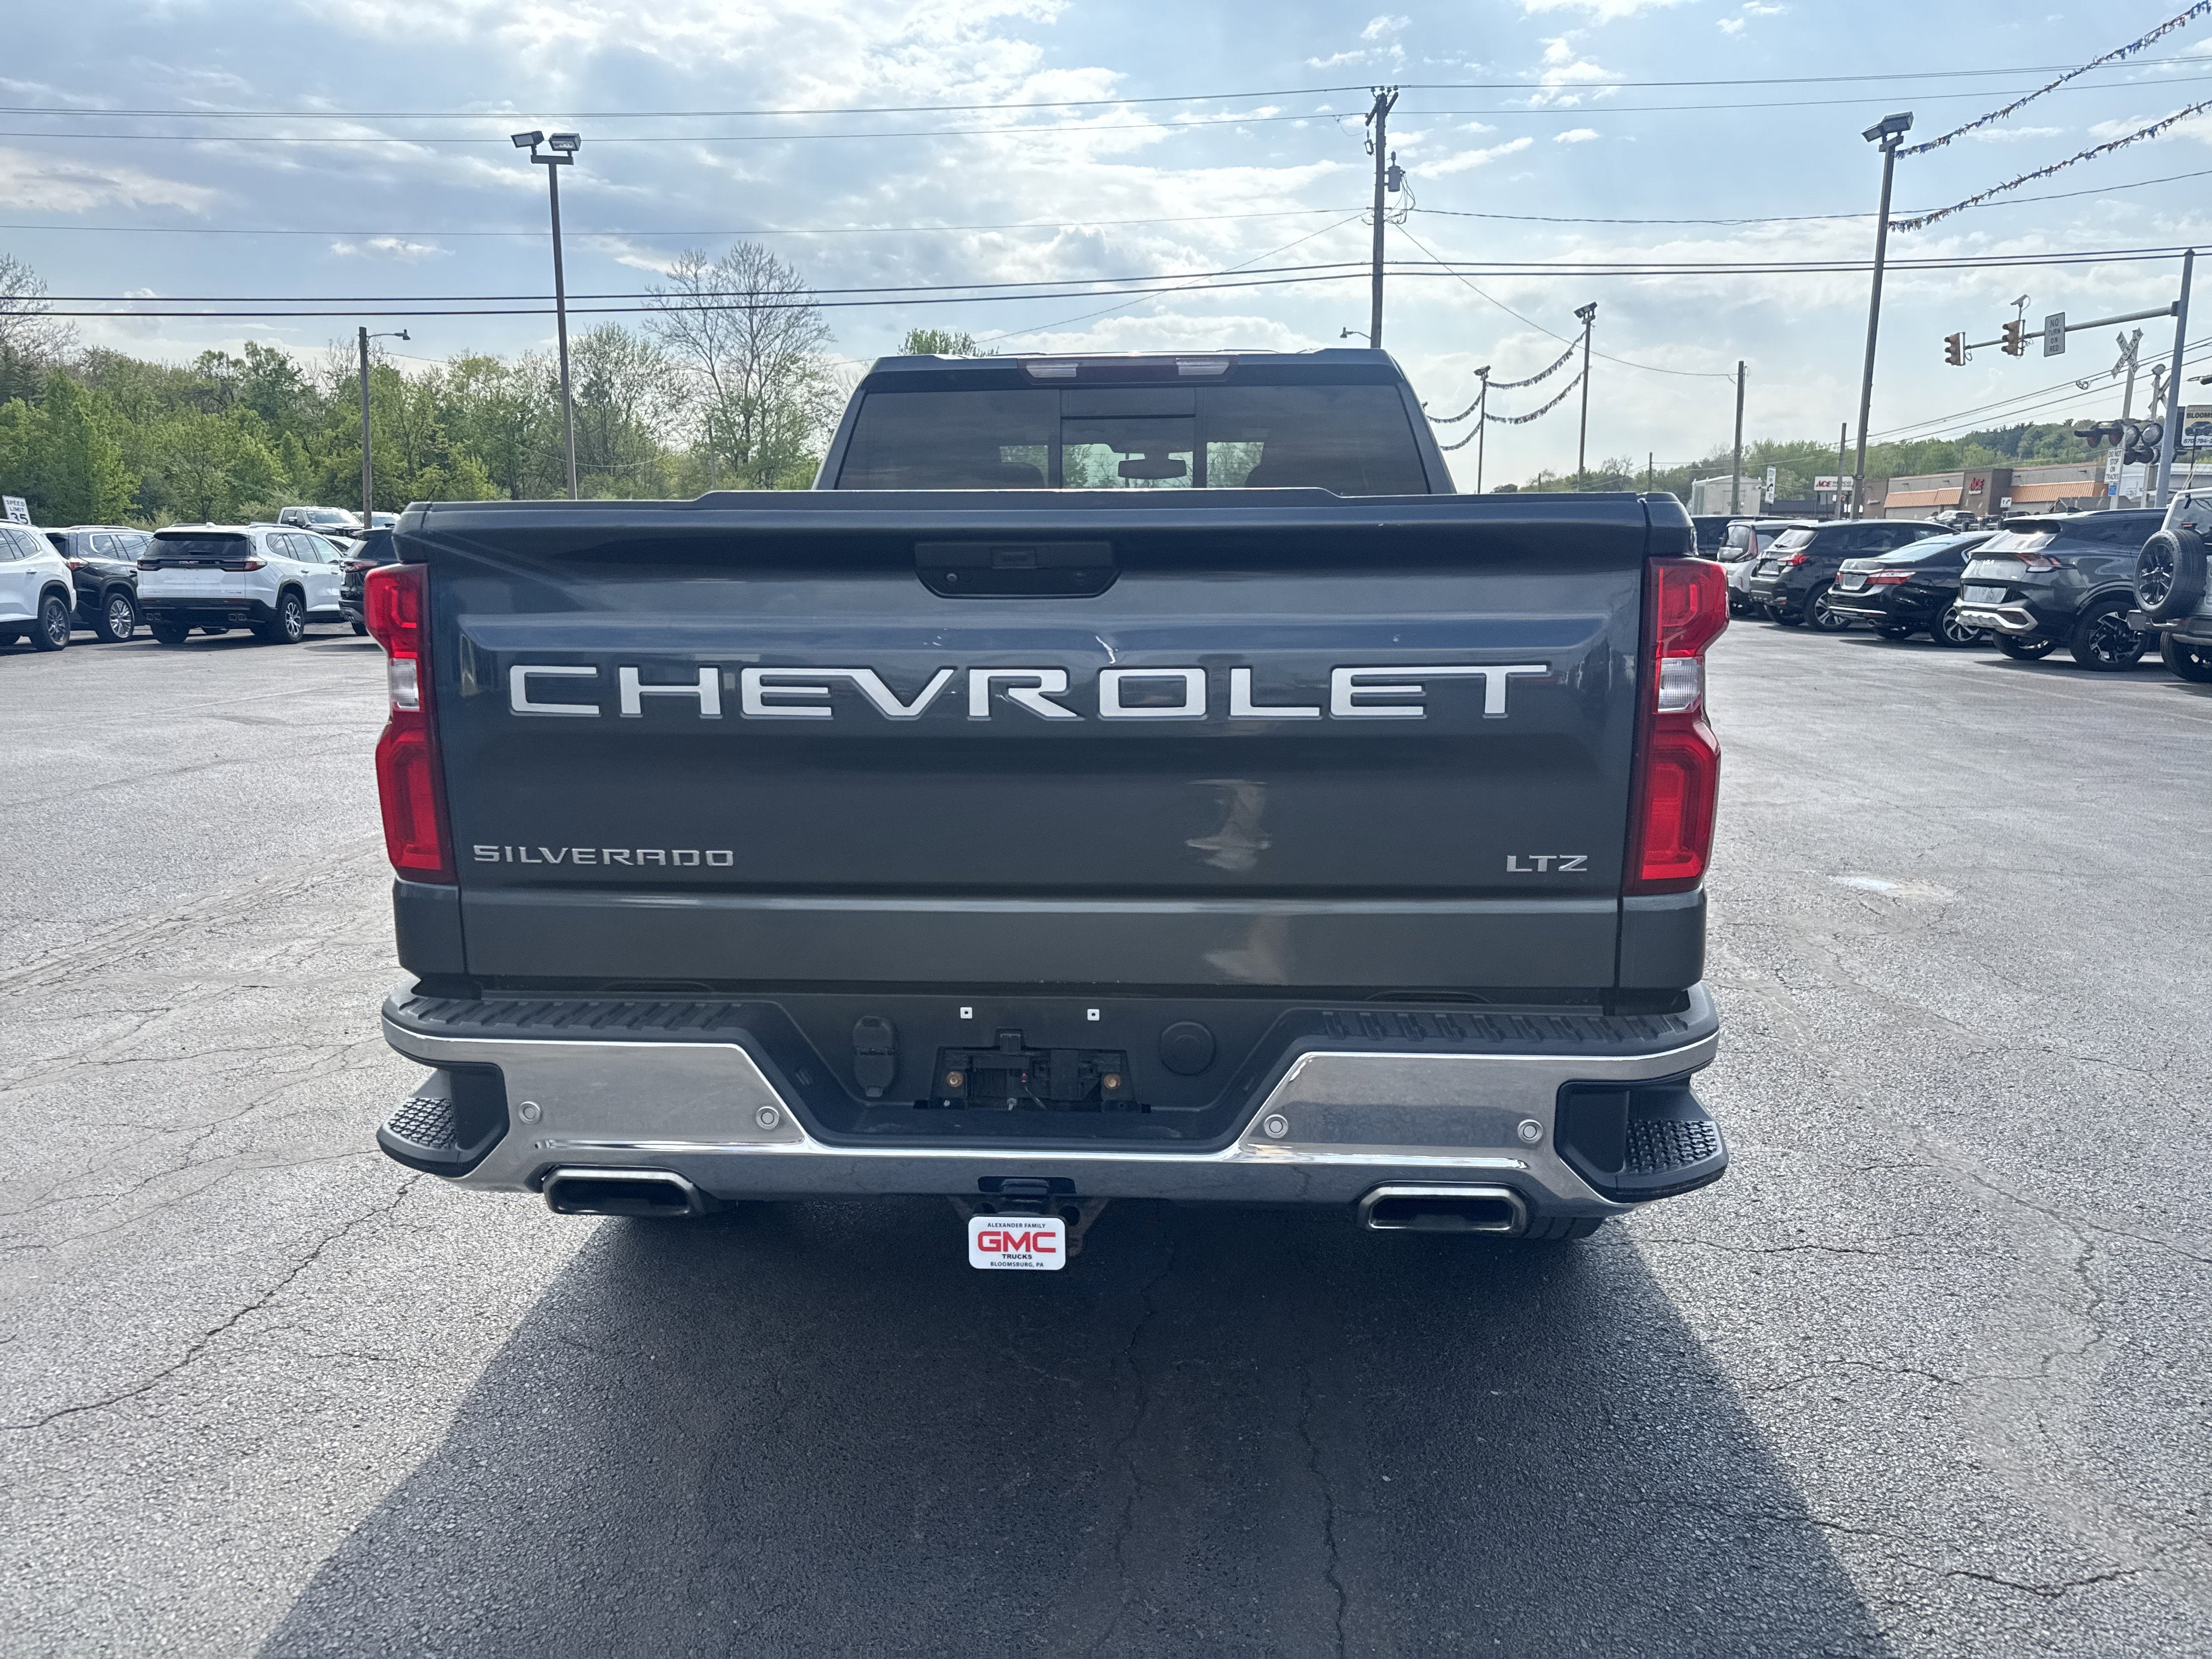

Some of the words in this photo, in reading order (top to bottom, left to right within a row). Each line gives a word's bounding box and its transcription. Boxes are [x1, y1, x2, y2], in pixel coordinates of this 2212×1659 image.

[2050, 318, 2059, 328] NO
[2048, 328, 2061, 336] TURN
[2112, 330, 2142, 376] CROSSING
[1969, 477, 1985, 490] ACE
[10, 512, 29, 524] 35
[510, 664, 1548, 719] CHEVROLET
[473, 845, 734, 866] SILVERADO
[1506, 855, 1588, 872] LTZ
[978, 1231, 1056, 1253] GMC
